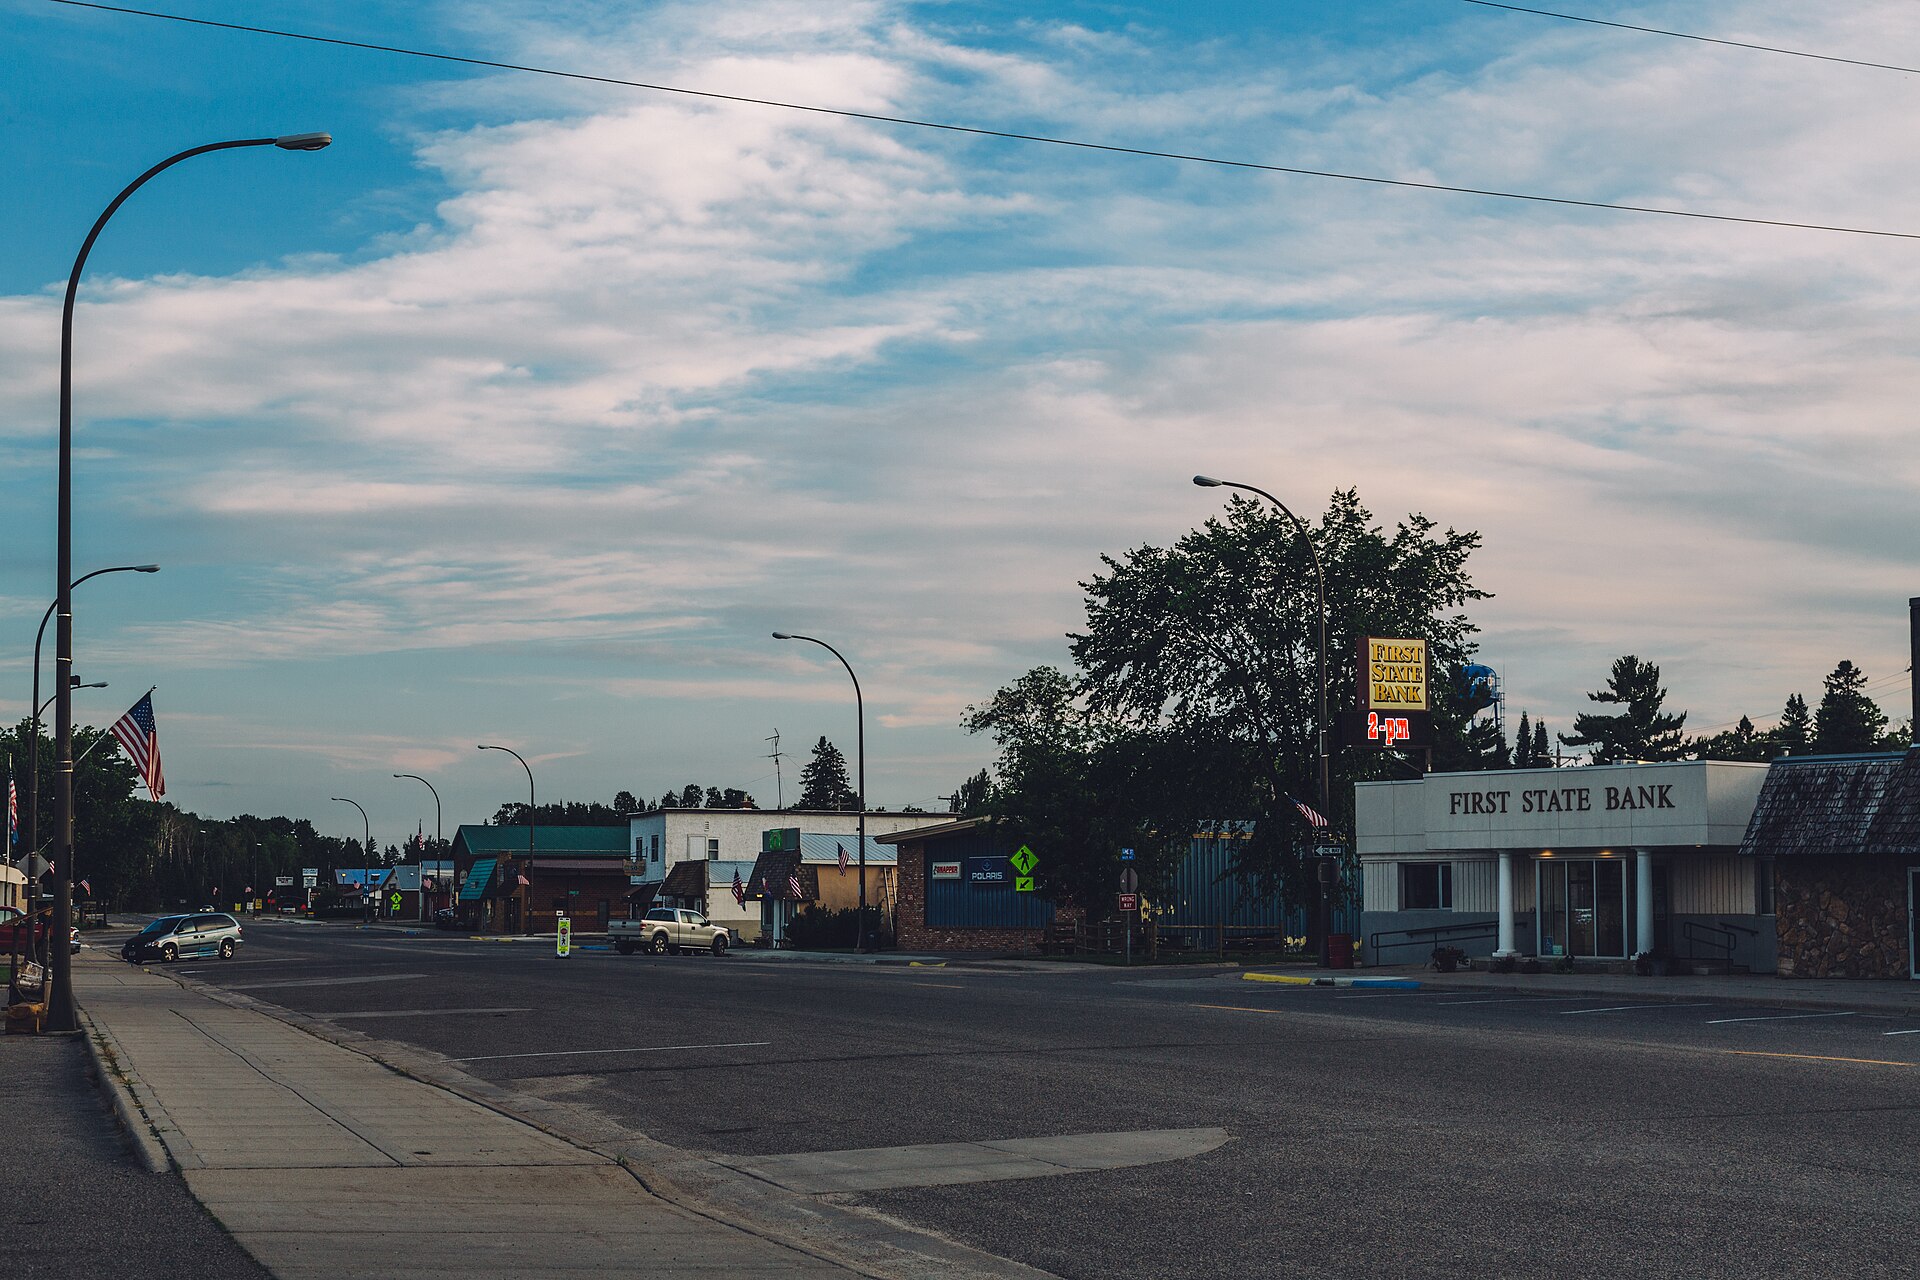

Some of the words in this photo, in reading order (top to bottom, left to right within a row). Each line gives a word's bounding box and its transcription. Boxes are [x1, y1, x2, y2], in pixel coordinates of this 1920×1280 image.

[1371, 643, 1423, 663] FIRST
[1372, 663, 1423, 683] STATE
[1373, 683, 1422, 703] BANK
[1450, 791, 1510, 815] FIRST
[1522, 788, 1591, 812] STATE
[1605, 784, 1675, 810] BANK
[971, 871, 1003, 880] POLARIS
